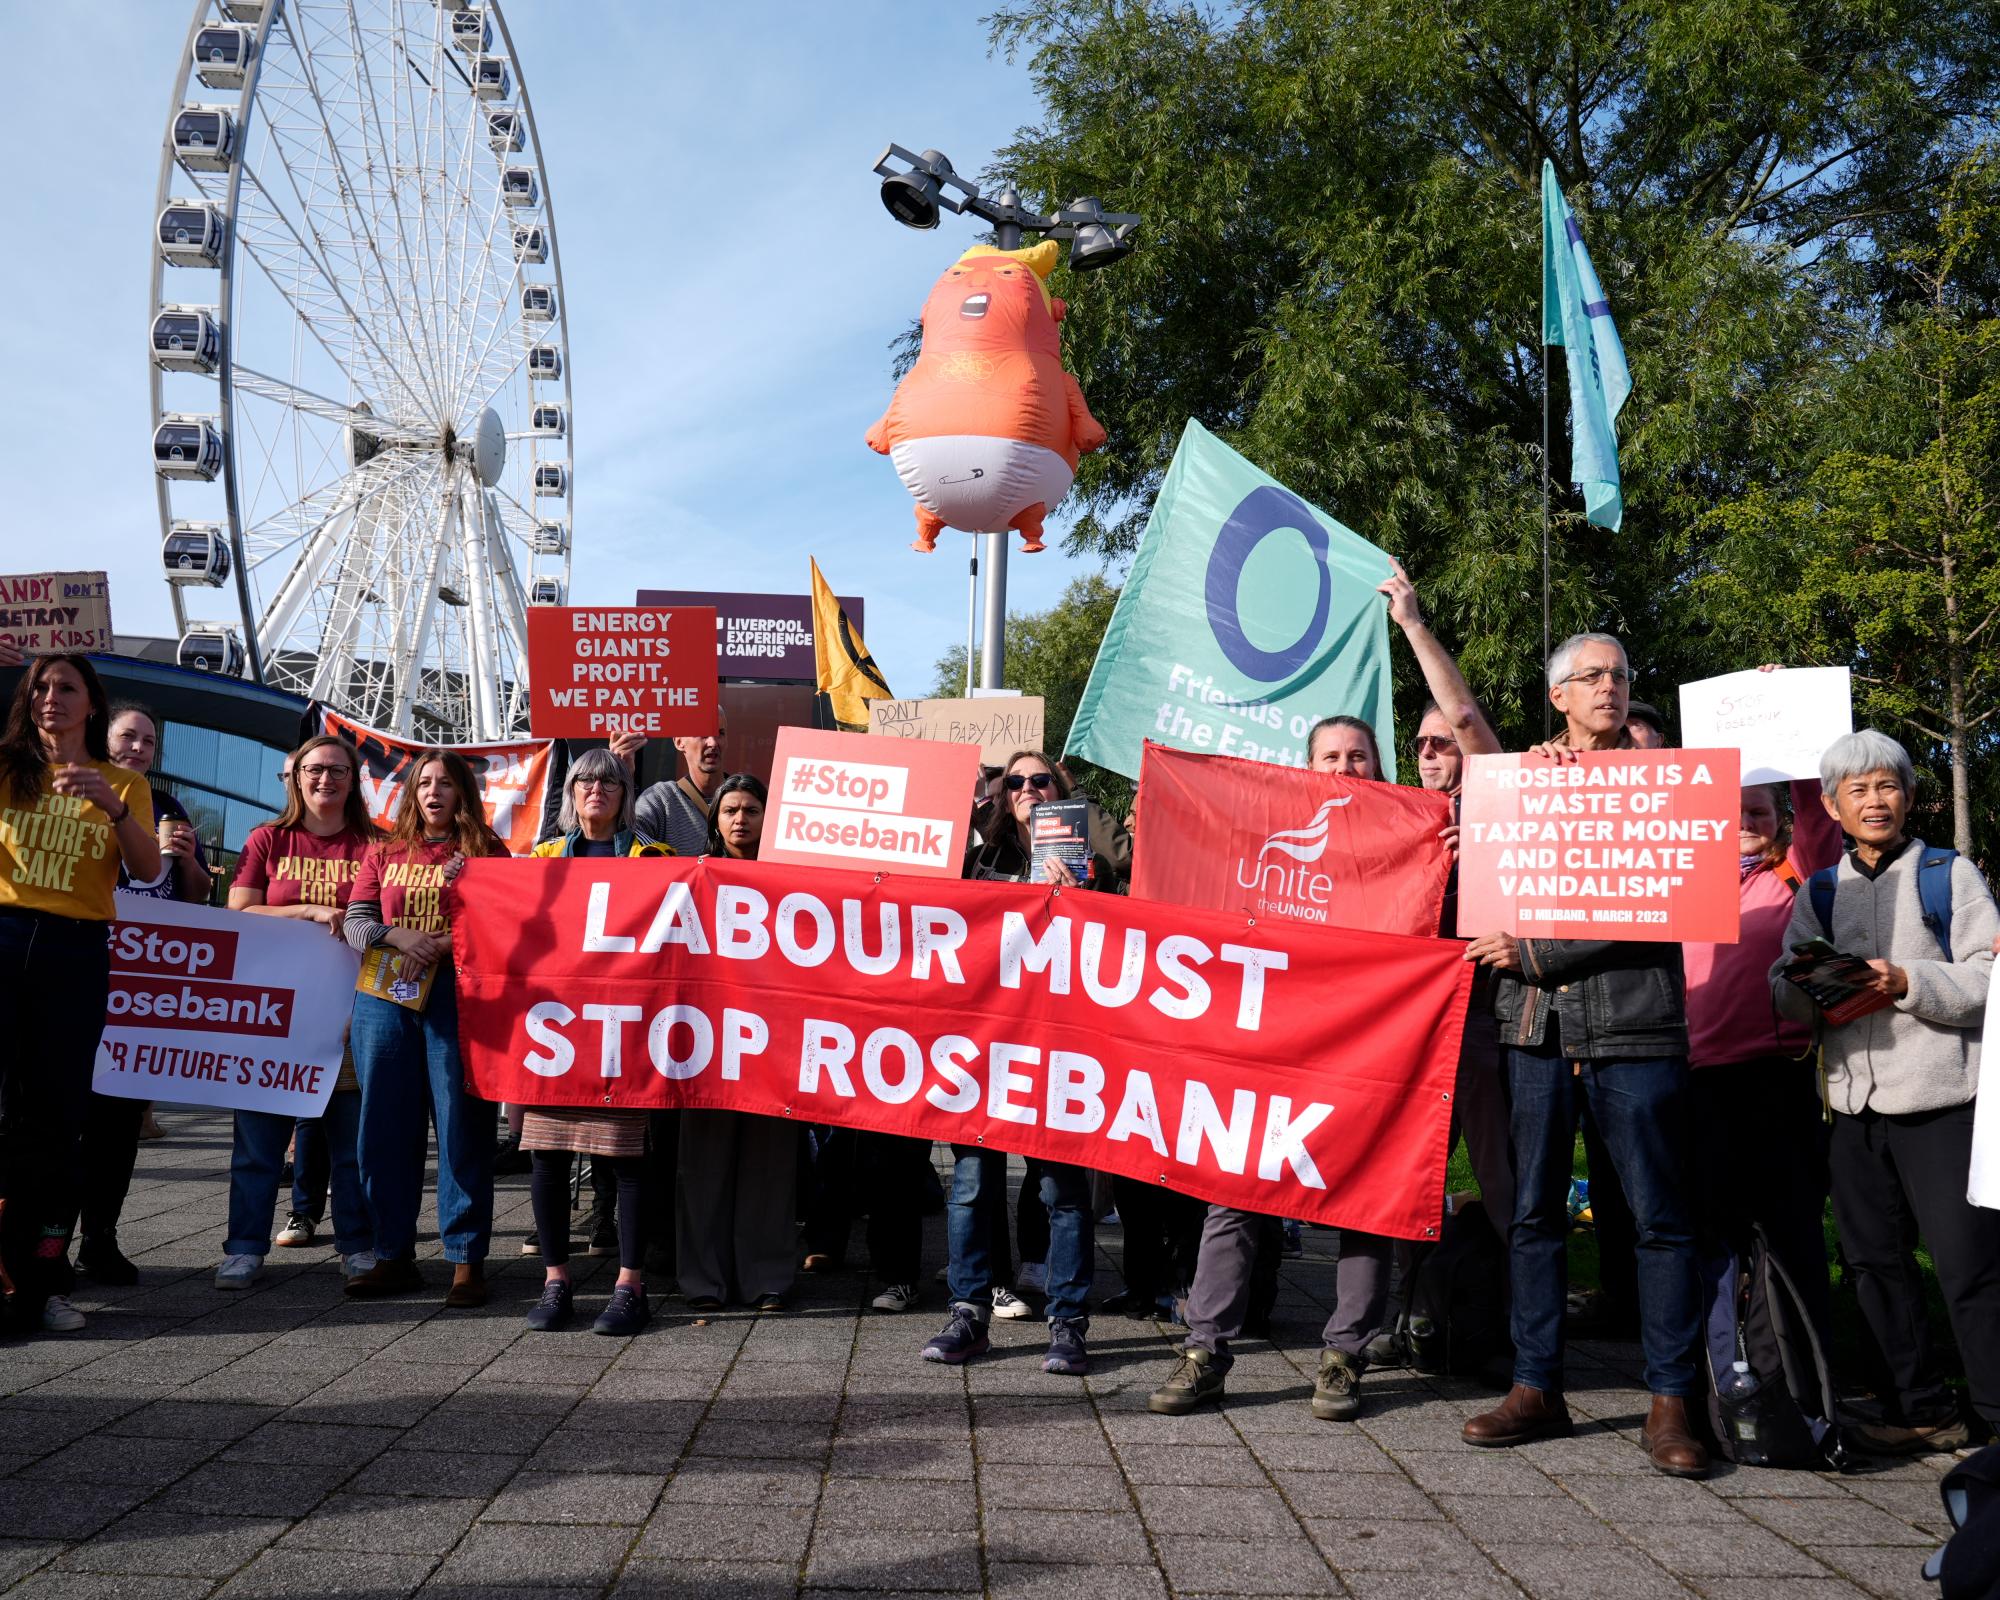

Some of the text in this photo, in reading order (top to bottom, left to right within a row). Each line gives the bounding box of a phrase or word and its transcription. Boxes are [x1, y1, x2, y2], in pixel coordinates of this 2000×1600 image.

[64, 582, 104, 597] DON'T
[572, 612, 673, 632] ENERGY
[727, 618, 804, 633] LIVERPOOL
[50, 629, 105, 648] KIDS!
[575, 637, 671, 657] GIANTS
[726, 643, 785, 658] CAMPUS
[727, 631, 813, 645] EXPERIENCE
[572, 663, 669, 684] PROFIT,
[549, 687, 699, 707] WE PAY THE
[1168, 663, 1284, 730] Friends
[590, 713, 661, 732] PRICE
[877, 700, 923, 724] DON'T
[1155, 702, 1214, 747] the
[950, 721, 989, 744] BABY
[990, 713, 1041, 746] DRILL
[791, 763, 889, 808] #Stop
[1486, 764, 1713, 789] "ROSEBANK IS A
[36, 793, 83, 819] FOR
[1522, 792, 1669, 815] WASTE OF
[1, 808, 109, 860] FUTURE'S
[785, 811, 944, 856] Rosebank
[1470, 819, 1729, 843] TAXPAYER MONEY
[12, 847, 79, 892] SAKE
[276, 856, 361, 884] PARENTS
[1497, 848, 1695, 870] AND CLIMATE
[383, 863, 451, 888] PAREN
[1237, 858, 1333, 904] unite
[1498, 876, 1683, 897] VANDALISM"
[301, 881, 337, 907] FOR
[404, 886, 440, 917] FOR
[1519, 909, 1668, 923] ED MILIBAND, MARCH 2023
[582, 882, 1289, 1031] LABOUR MUST
[106, 986, 284, 1027] osebank
[133, 1044, 254, 1086] FUTURE'S
[258, 1060, 325, 1095] SAKE
[523, 1001, 1335, 1190] STOP ROSEBANK
